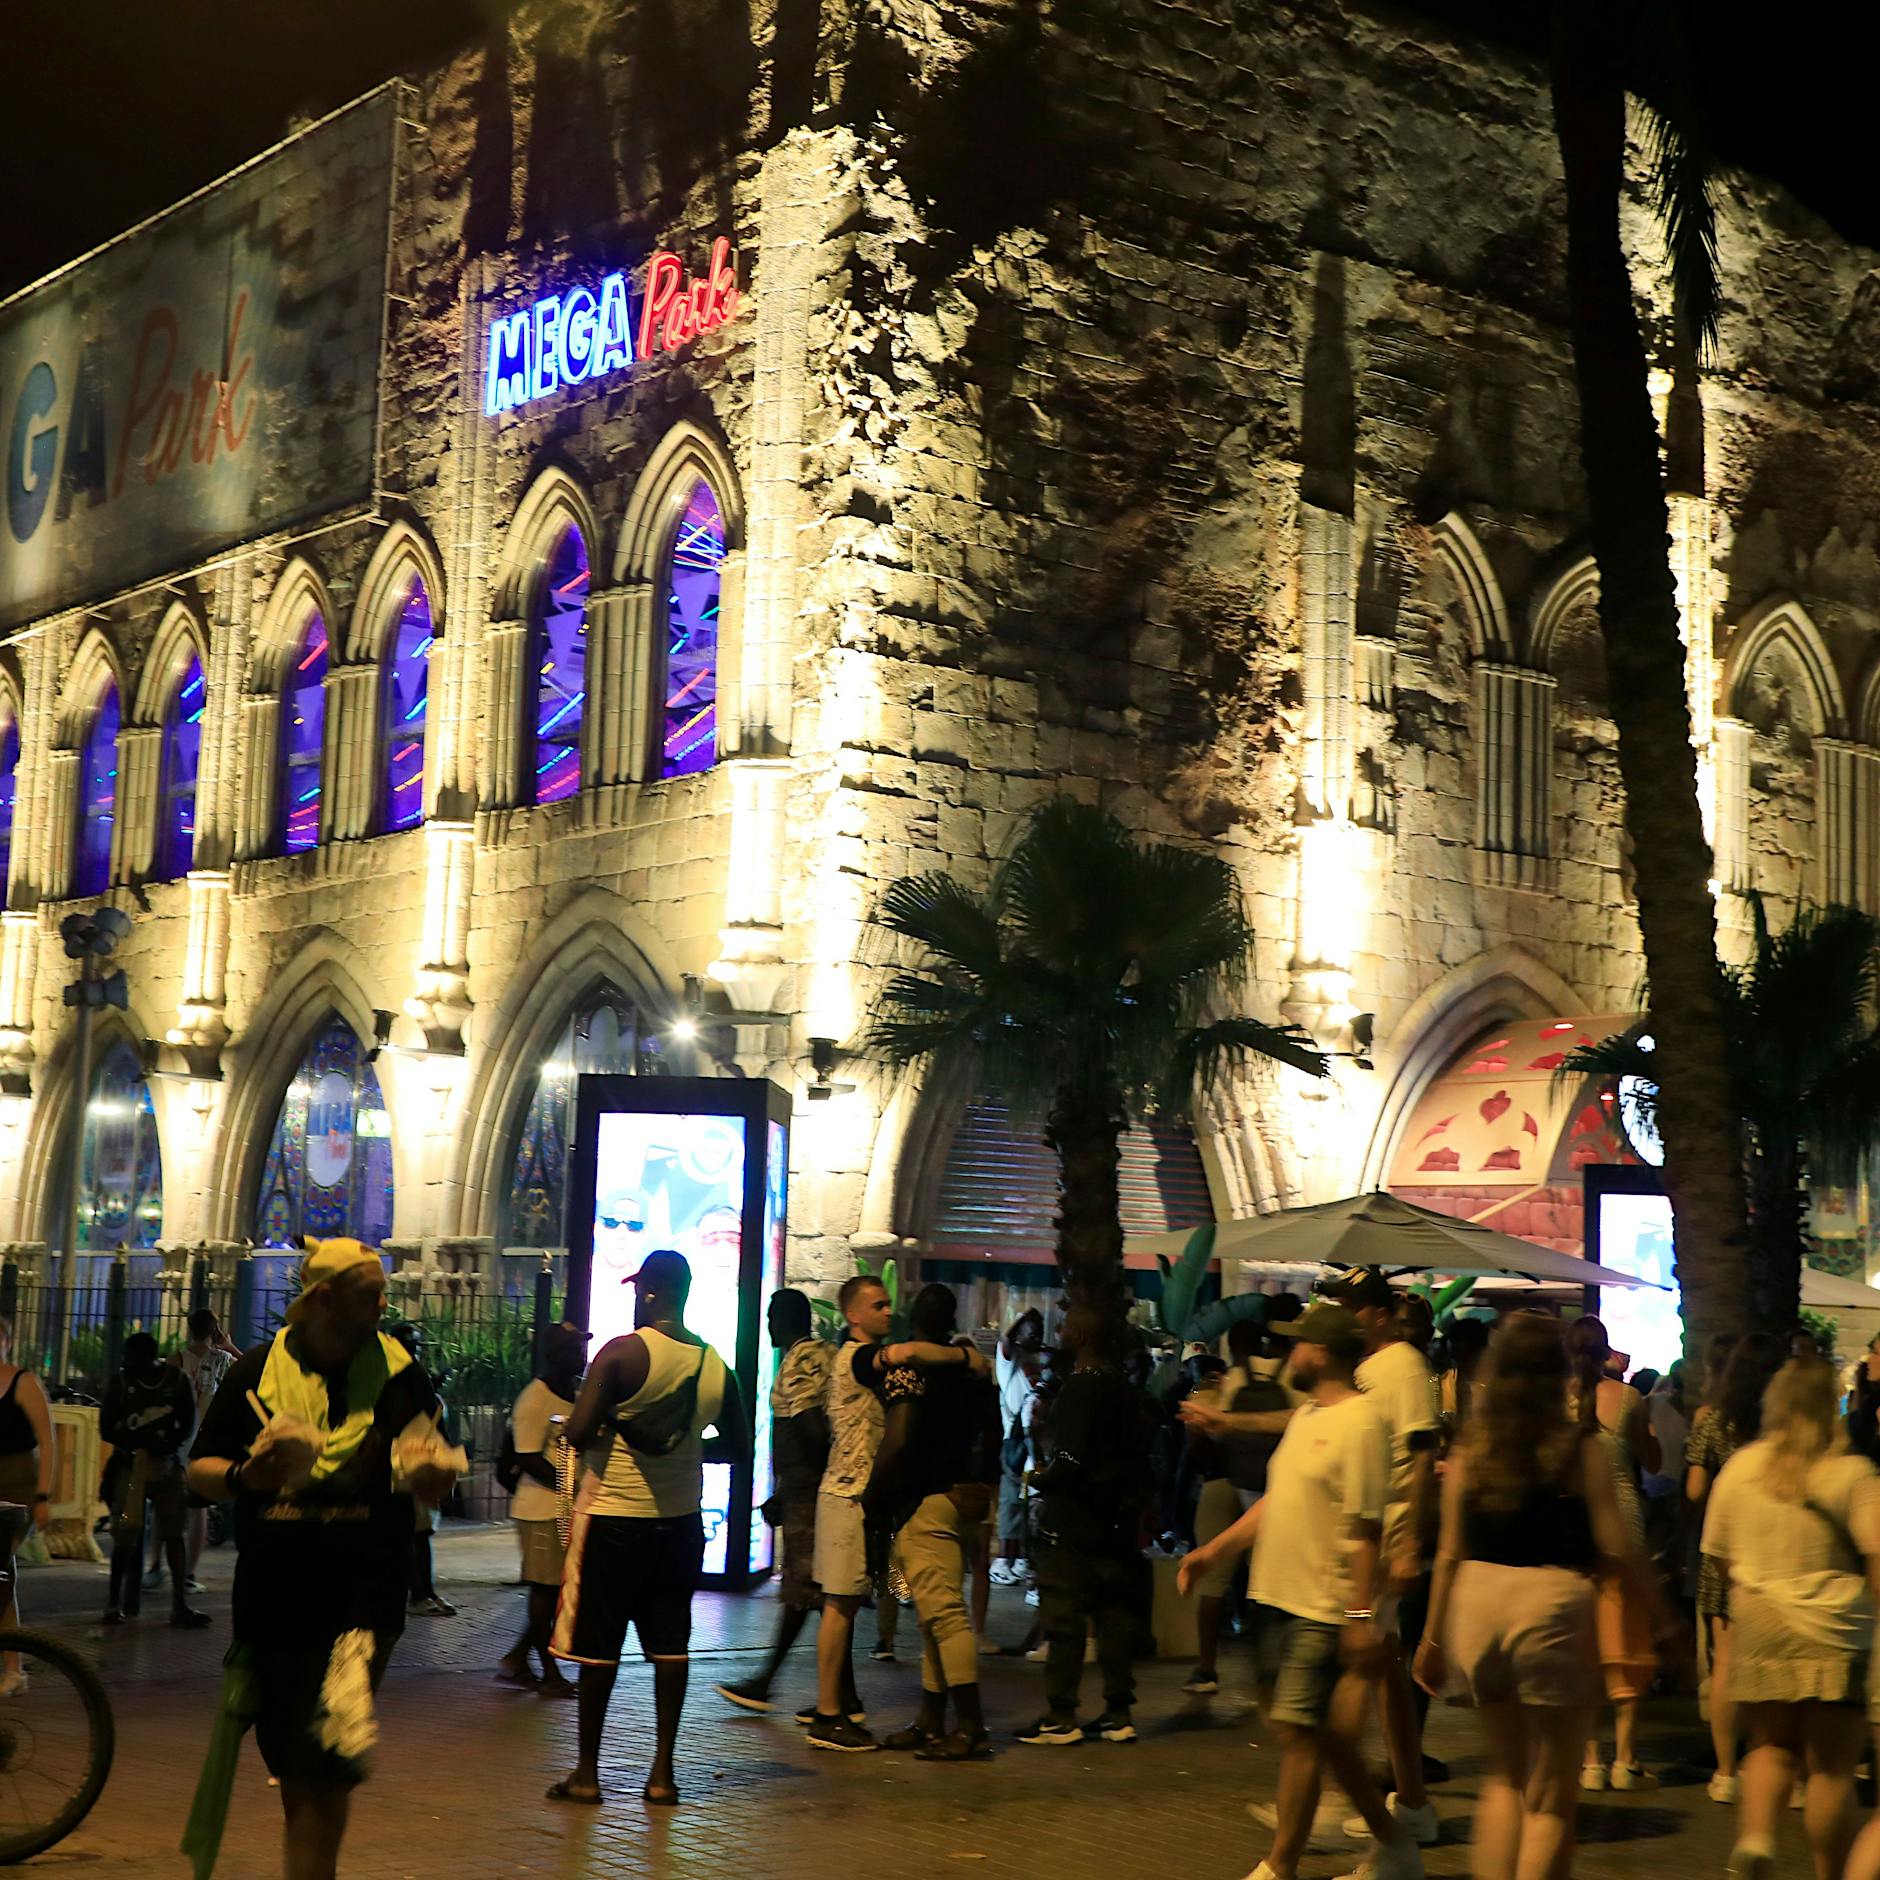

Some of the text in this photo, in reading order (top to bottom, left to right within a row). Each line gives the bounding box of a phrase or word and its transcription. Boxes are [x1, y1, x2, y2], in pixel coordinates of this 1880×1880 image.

[111, 291, 256, 498] Park
[484, 235, 742, 417] MEGA Park
